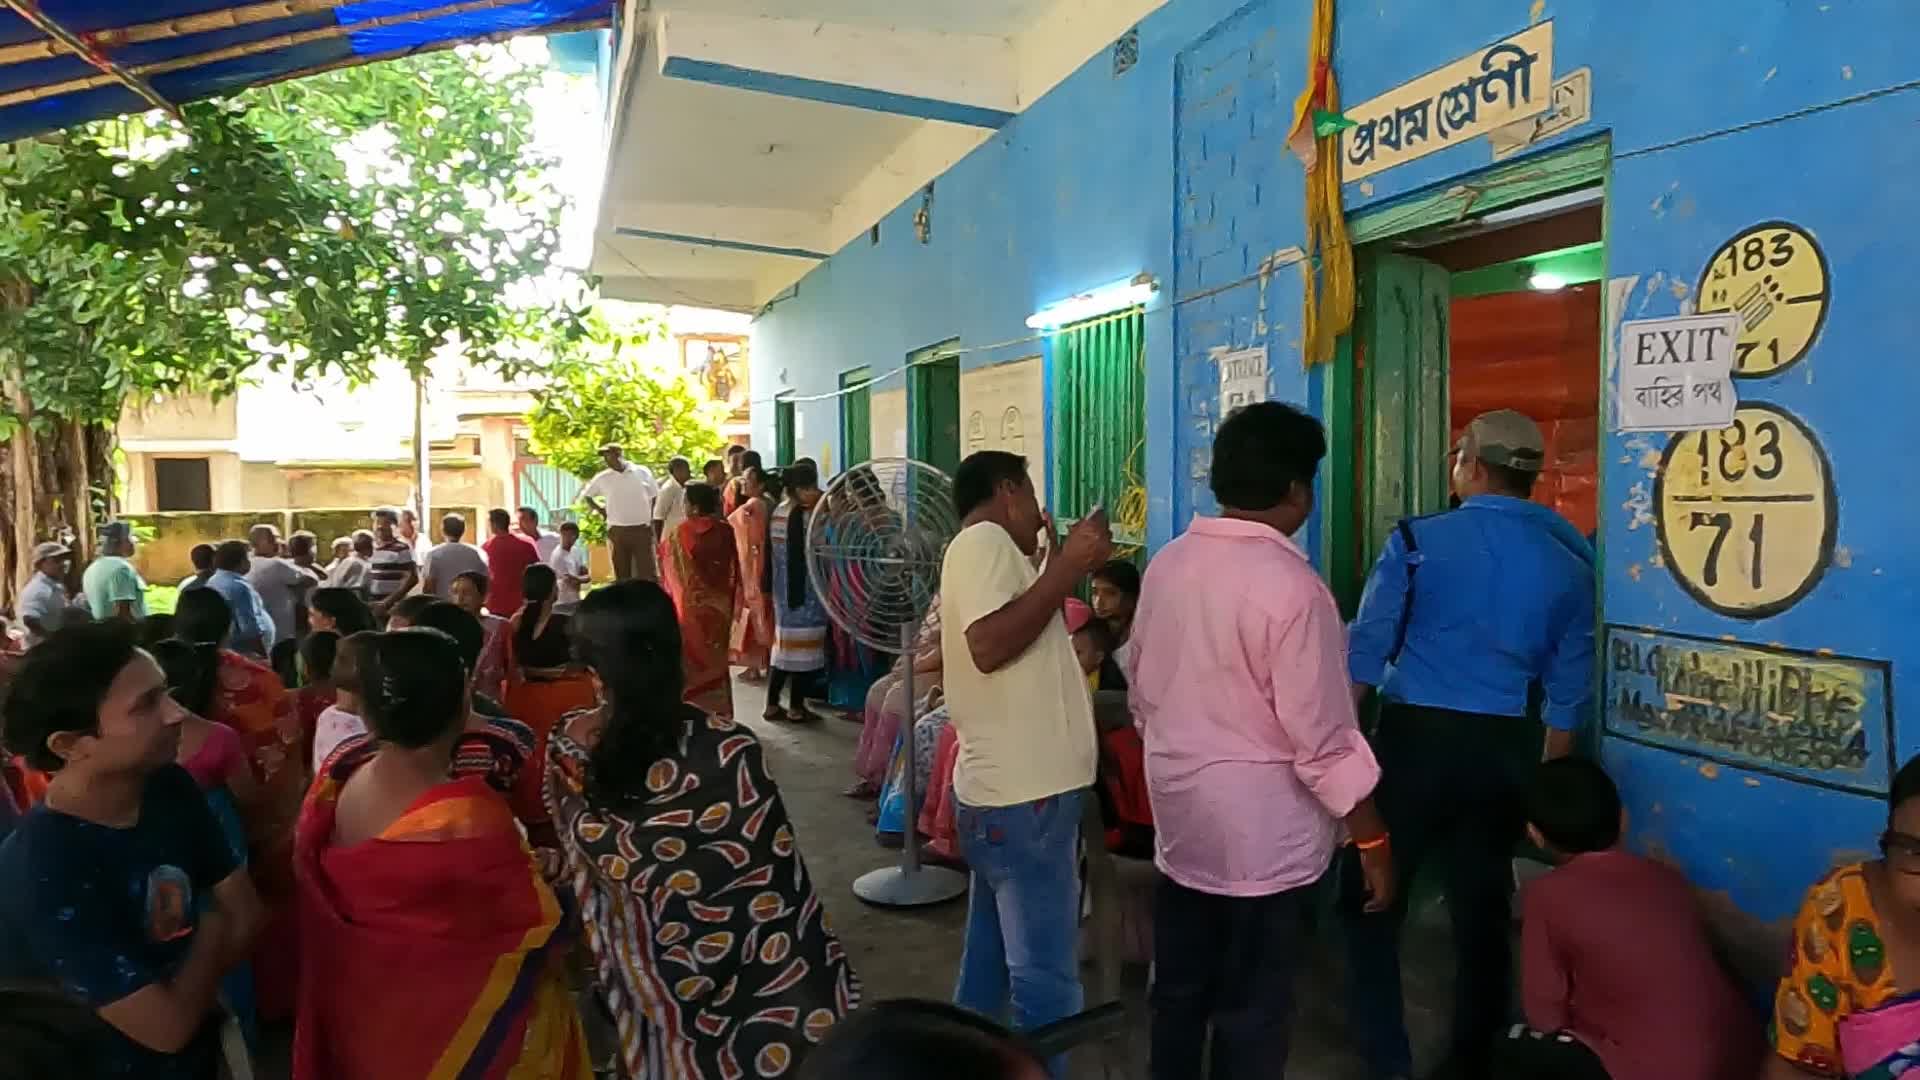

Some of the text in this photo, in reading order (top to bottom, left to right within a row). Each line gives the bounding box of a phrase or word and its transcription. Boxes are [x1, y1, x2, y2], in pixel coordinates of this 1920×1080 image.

[1348, 97, 1433, 166] প্রথম
[1436, 44, 1539, 140] শ্রেণী
[1724, 232, 1794, 277] 183
[1634, 327, 1729, 366] EXIT
[1735, 337, 1779, 370] 71
[1692, 381, 1722, 405] পথ
[1697, 418, 1783, 486] 183
[1688, 511, 1765, 590] 71
